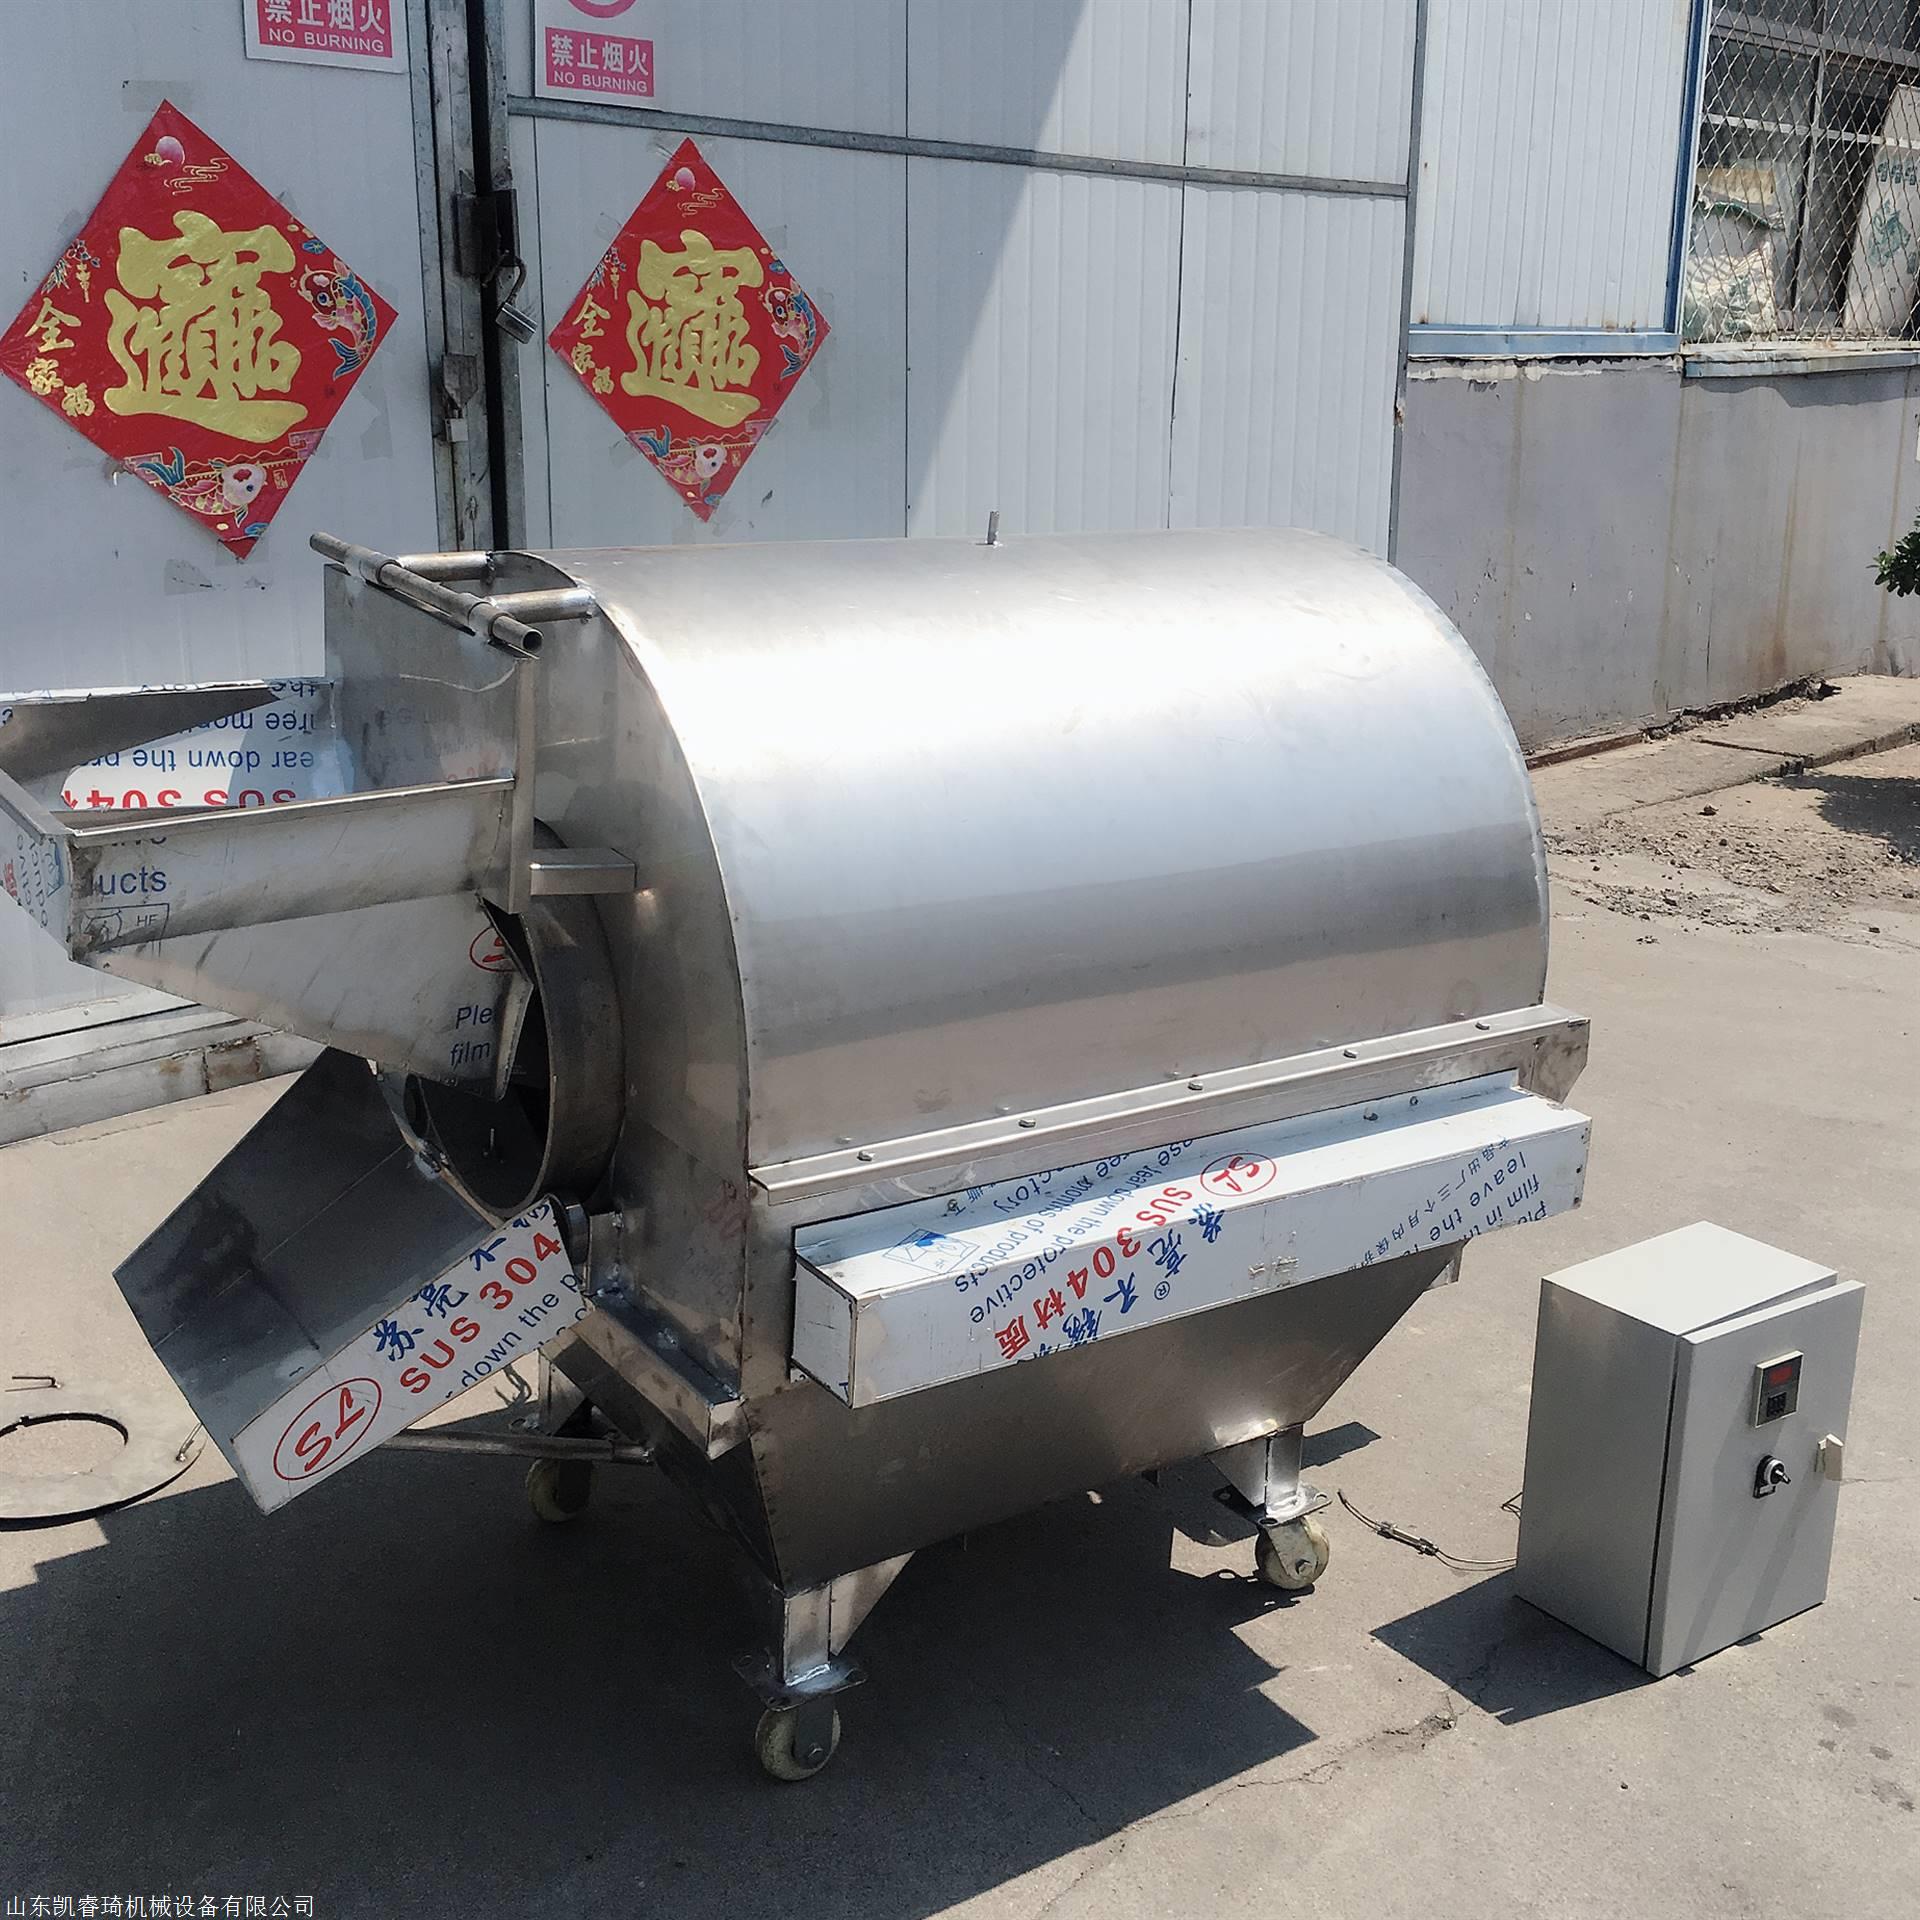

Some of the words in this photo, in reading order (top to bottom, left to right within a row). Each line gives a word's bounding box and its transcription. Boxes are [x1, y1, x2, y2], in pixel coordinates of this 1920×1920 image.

[269, 28, 295, 43] NO
[304, 32, 384, 52] BURNING
[552, 34, 648, 76] 禁止烟火
[554, 70, 575, 85] NO
[582, 74, 648, 93] BURNING
[132, 750, 176, 772] the
[188, 750, 260, 773] down
[271, 751, 315, 768] ear
[99, 865, 168, 895] ucts
[450, 1042, 491, 1071] film
[1469, 1151, 1527, 1207] leave
[1506, 1173, 1540, 1208] film
[1136, 1187, 1193, 1227] SUS
[1486, 1205, 1504, 1226] in
[1067, 1216, 1103, 1235] the
[1430, 1208, 1463, 1241] the
[954, 1229, 1029, 1293] products
[969, 1233, 1075, 1324] protective
[400, 1315, 482, 1394] SUS
[479, 1231, 563, 1311] 304
[460, 1329, 523, 1388] down
[517, 1292, 561, 1329] the
